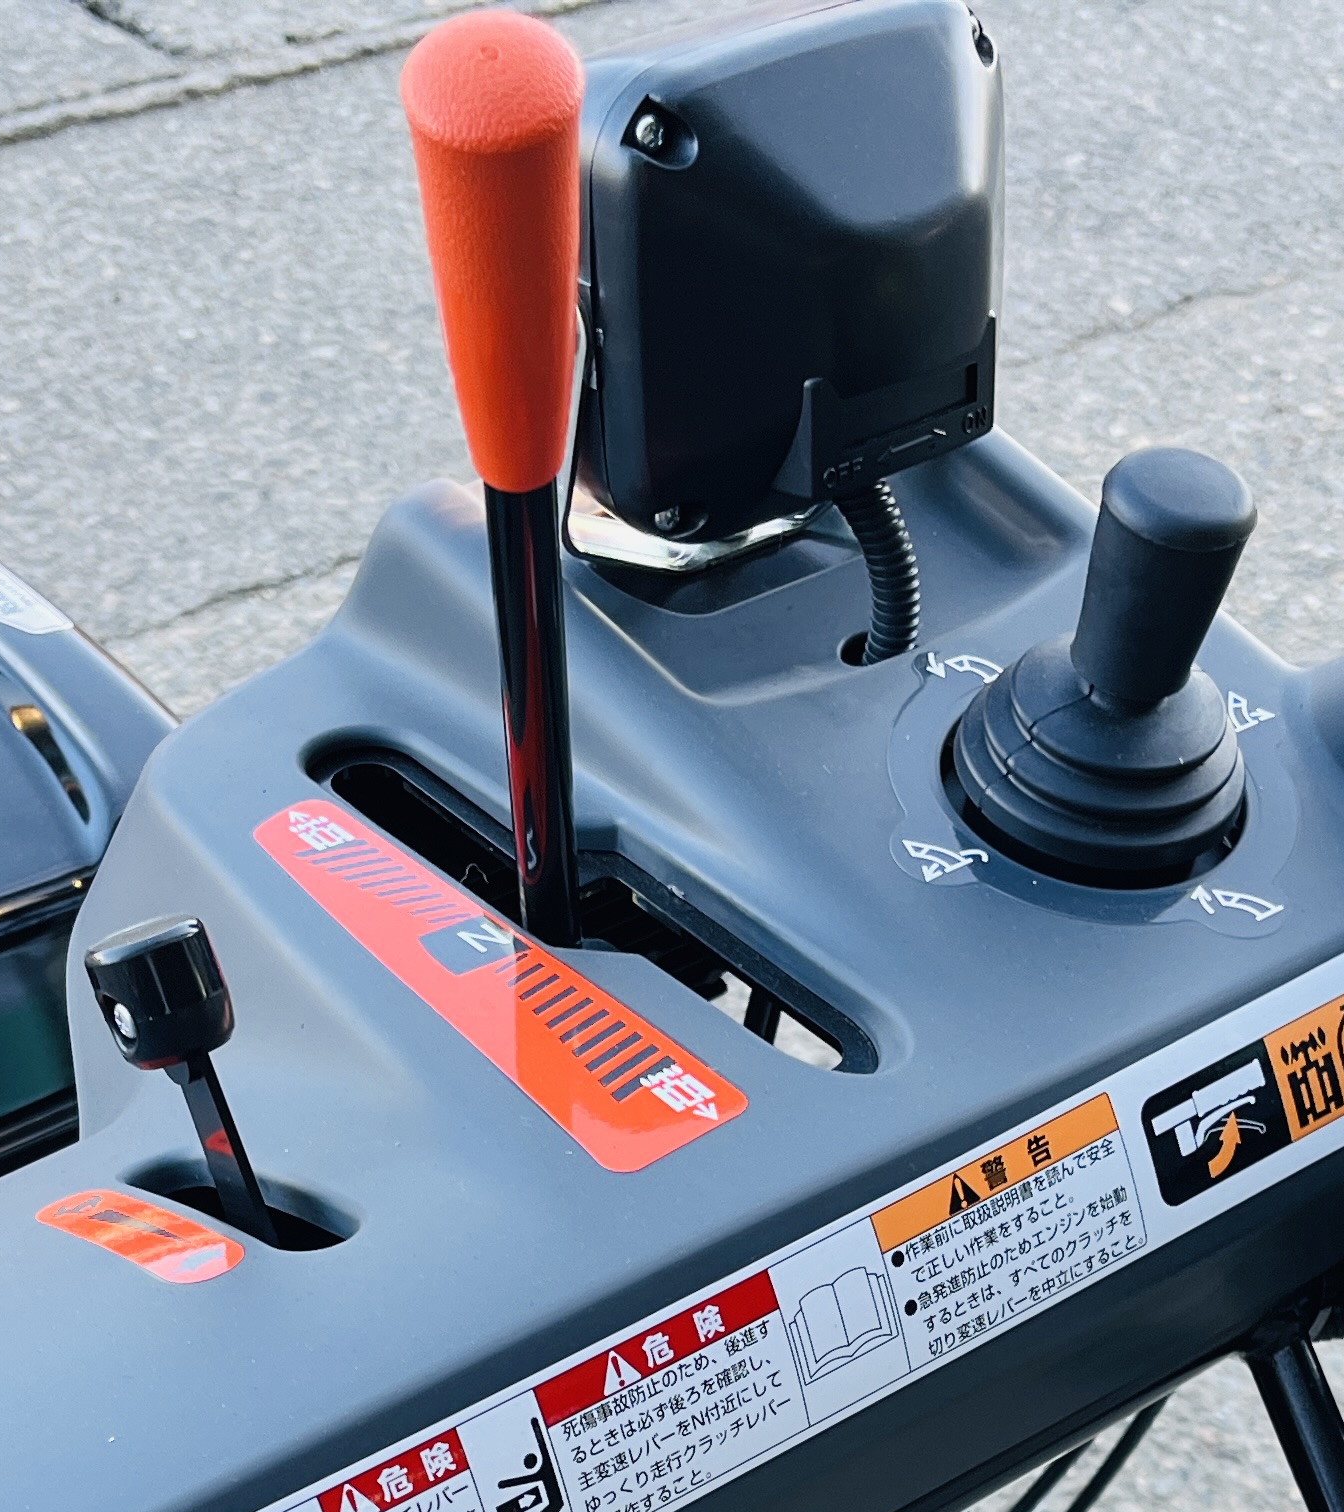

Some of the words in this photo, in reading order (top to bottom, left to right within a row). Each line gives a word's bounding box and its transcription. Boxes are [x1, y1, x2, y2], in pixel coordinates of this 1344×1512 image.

[962, 405, 988, 434] ON
[457, 922, 511, 953] N
[904, 1138, 1115, 1262] 作業前に取扱説明書を読んで安全
[979, 1133, 1053, 1192] 警告
[910, 1191, 1075, 1284] で正しい作業をすること。
[916, 1184, 1128, 1312] 急発進防止のためエンジンを始動
[922, 1209, 1132, 1333] するときは、すべてのクラッチを
[560, 1318, 771, 1442] 死傷事故防止のため、後進す
[641, 1304, 725, 1368] 危険
[569, 1354, 774, 1464] るときは必ず後ろを確認し、
[576, 1369, 783, 1492] 主変速レバーをN付近にして
[376, 1441, 457, 1503] 危険
